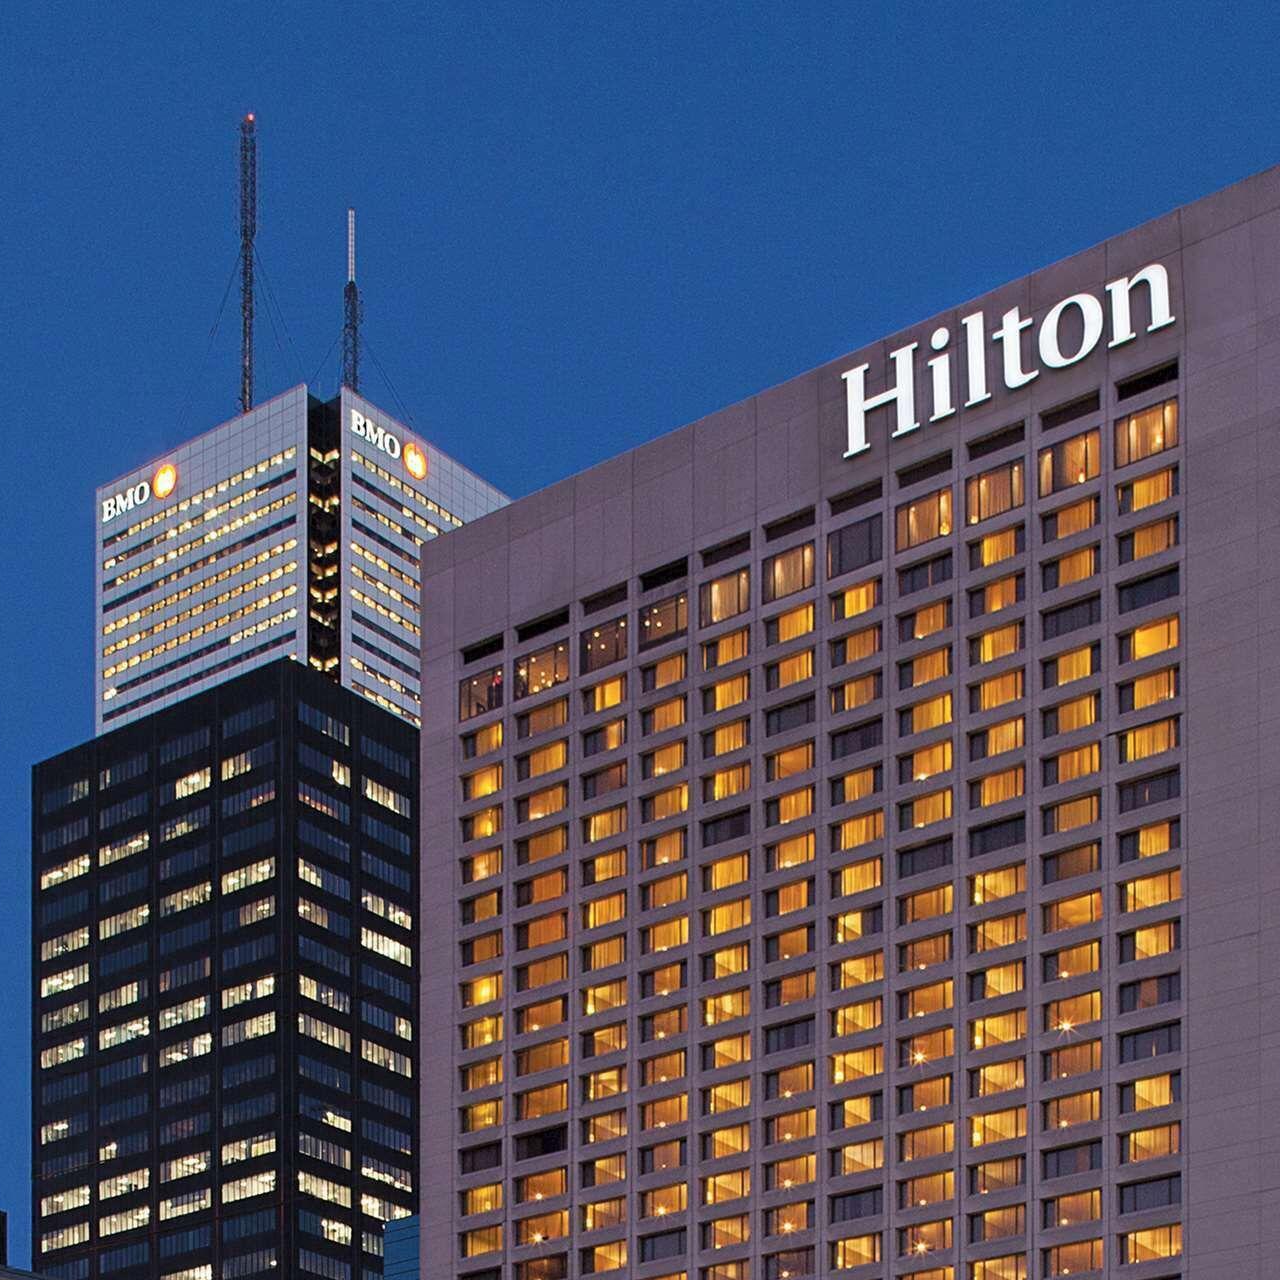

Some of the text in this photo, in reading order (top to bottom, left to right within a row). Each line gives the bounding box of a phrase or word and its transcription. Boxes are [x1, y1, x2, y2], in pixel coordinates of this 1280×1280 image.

[841, 263, 1176, 458] Hilton
[351, 409, 401, 460] BMO
[102, 480, 150, 523] BMO
